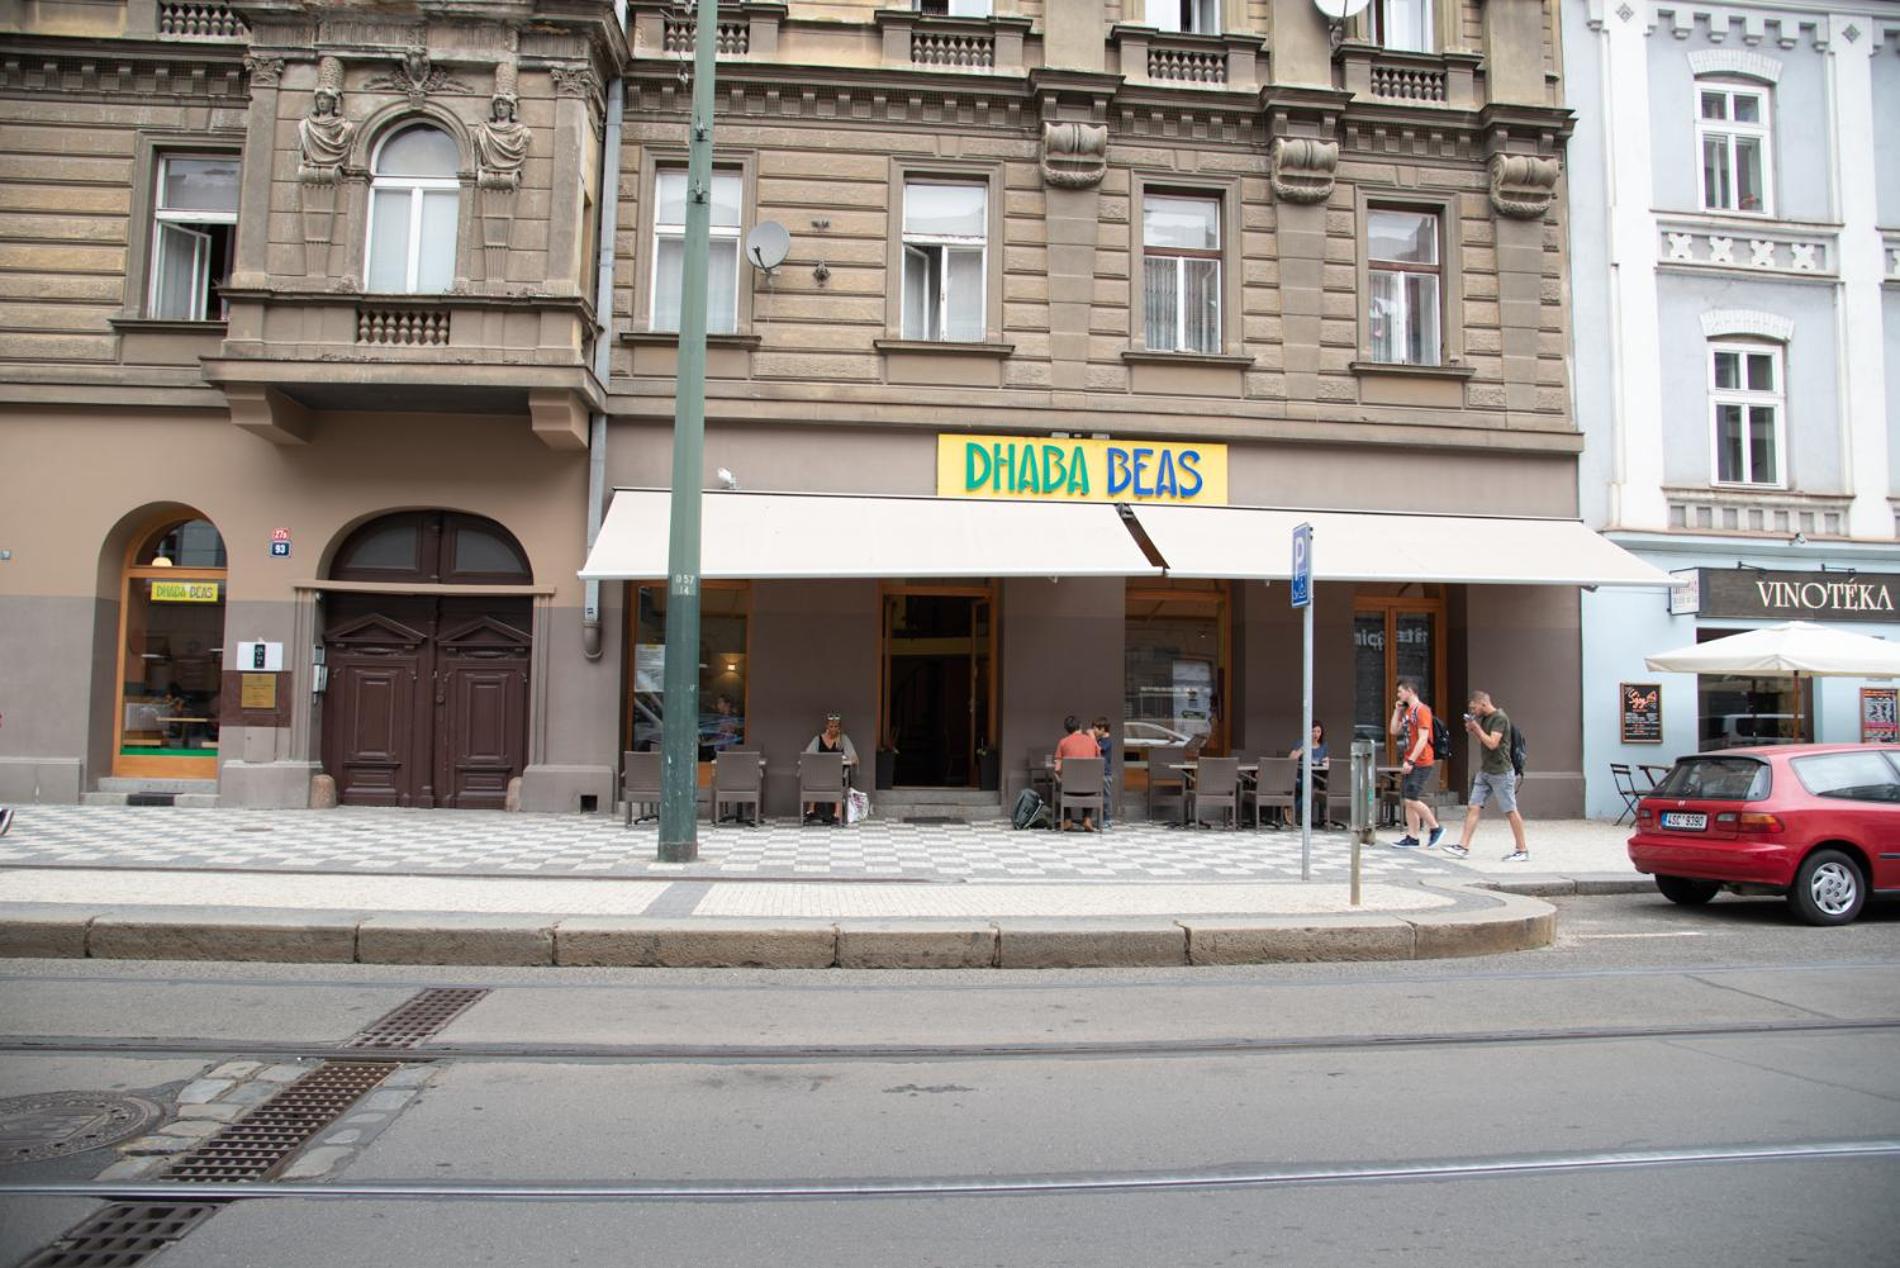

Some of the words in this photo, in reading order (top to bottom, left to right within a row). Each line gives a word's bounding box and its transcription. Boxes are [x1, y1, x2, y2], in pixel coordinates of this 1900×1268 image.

[965, 442, 1090, 495] DHABA
[1107, 447, 1203, 498] BEAS
[275, 544, 286, 554] 93
[1295, 536, 1305, 581] P
[1756, 577, 1894, 612] VINOTÉKA
